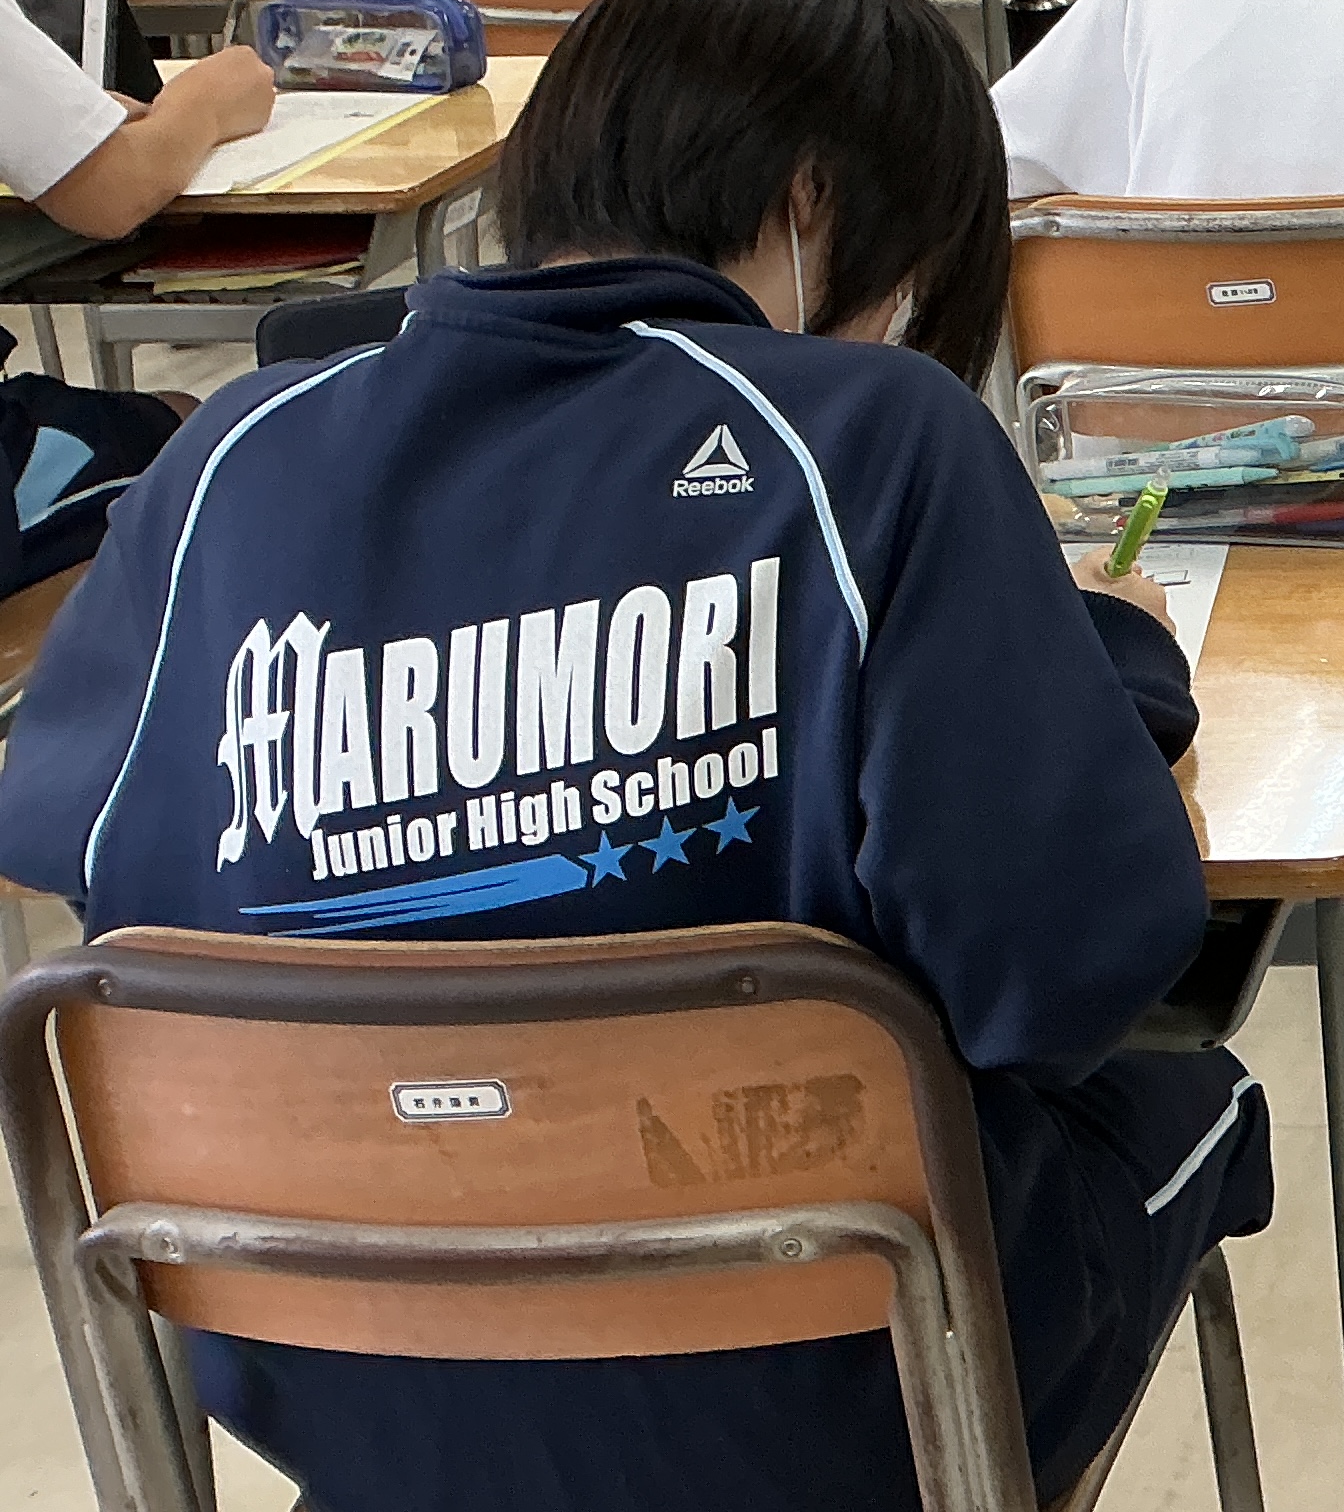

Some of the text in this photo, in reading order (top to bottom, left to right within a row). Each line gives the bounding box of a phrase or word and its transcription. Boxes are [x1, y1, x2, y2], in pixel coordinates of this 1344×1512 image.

[673, 474, 754, 499] Reebok
[216, 557, 781, 873] MARUMORI
[312, 726, 780, 882] Junior High School
